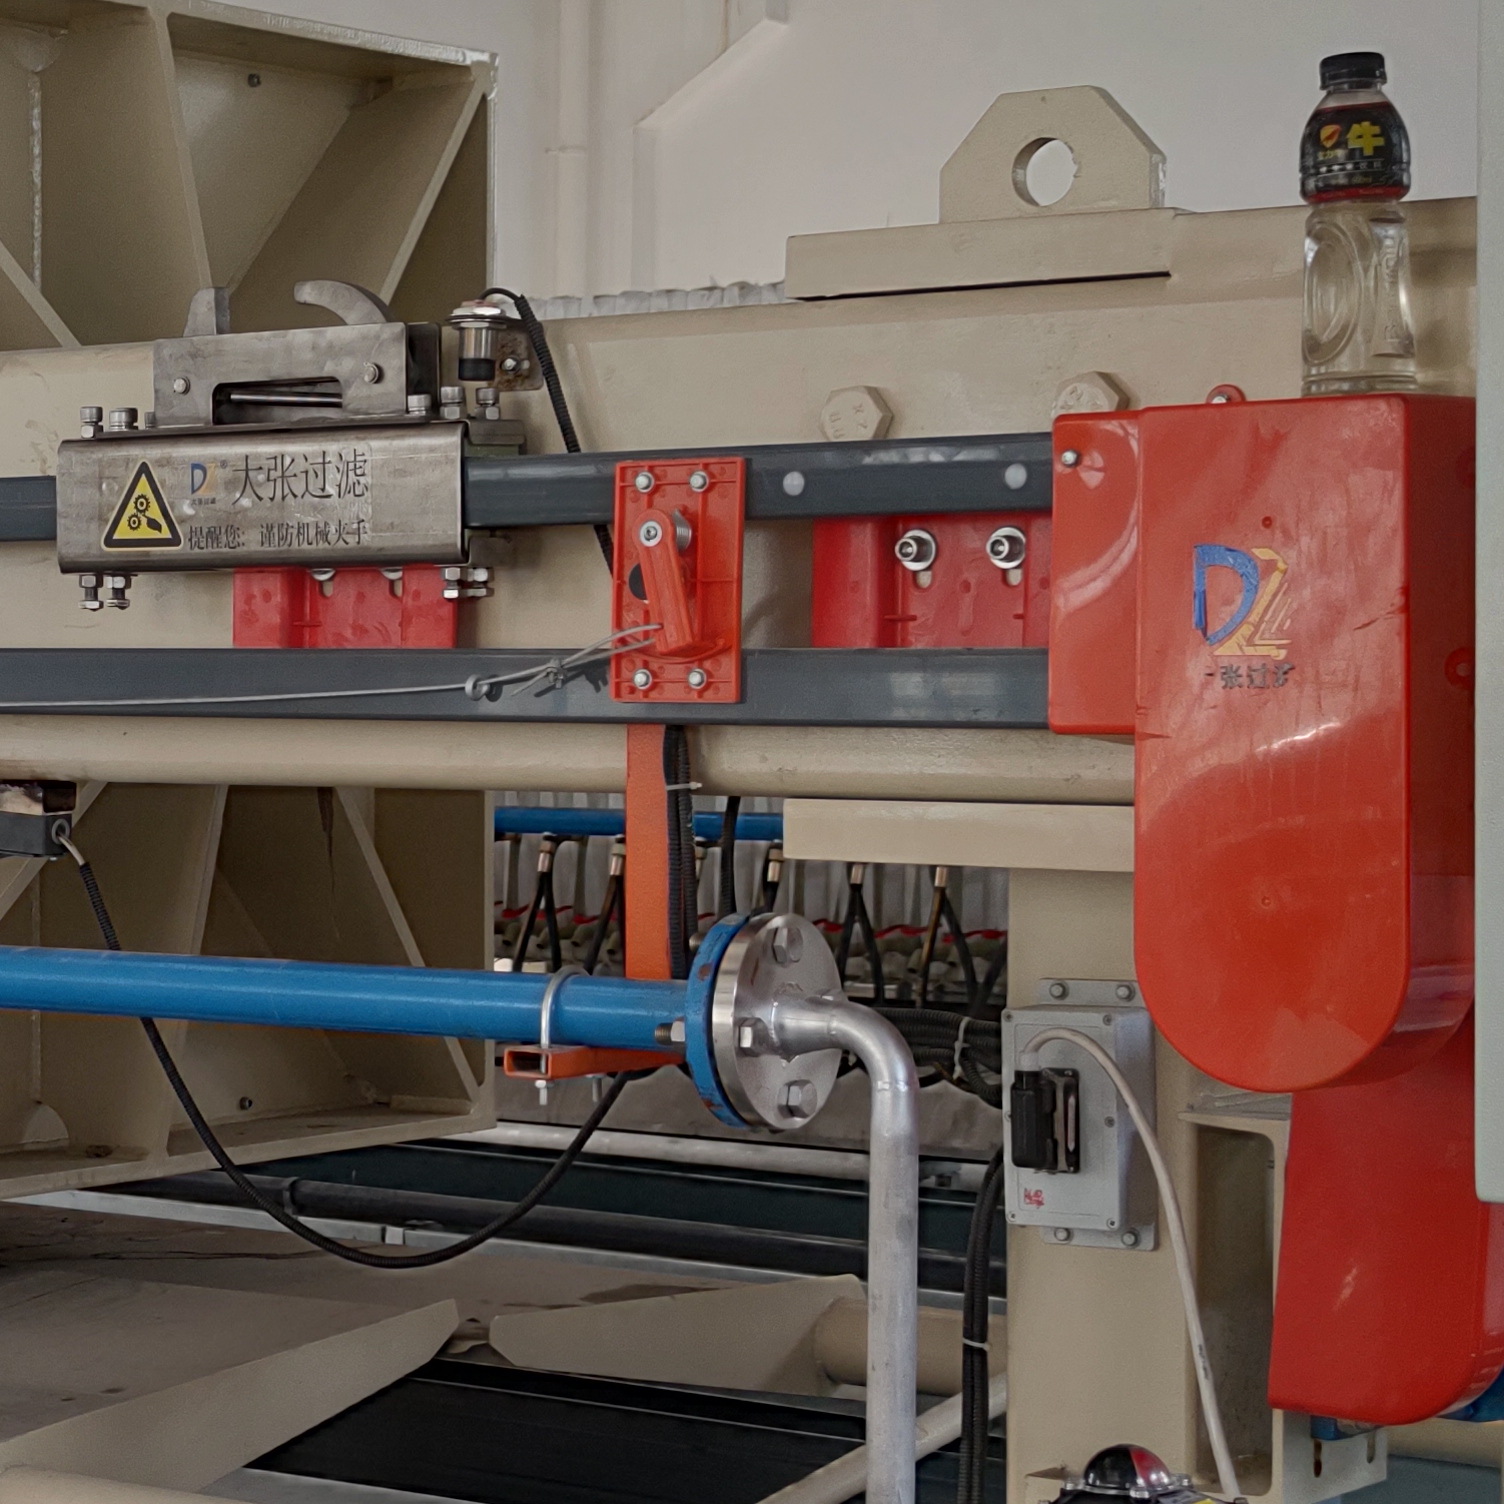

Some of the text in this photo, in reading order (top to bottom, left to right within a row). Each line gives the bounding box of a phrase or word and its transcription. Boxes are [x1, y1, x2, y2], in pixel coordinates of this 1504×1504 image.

[231, 448, 369, 506] 大张过滤
[259, 518, 369, 549] 谨防机械夹手
